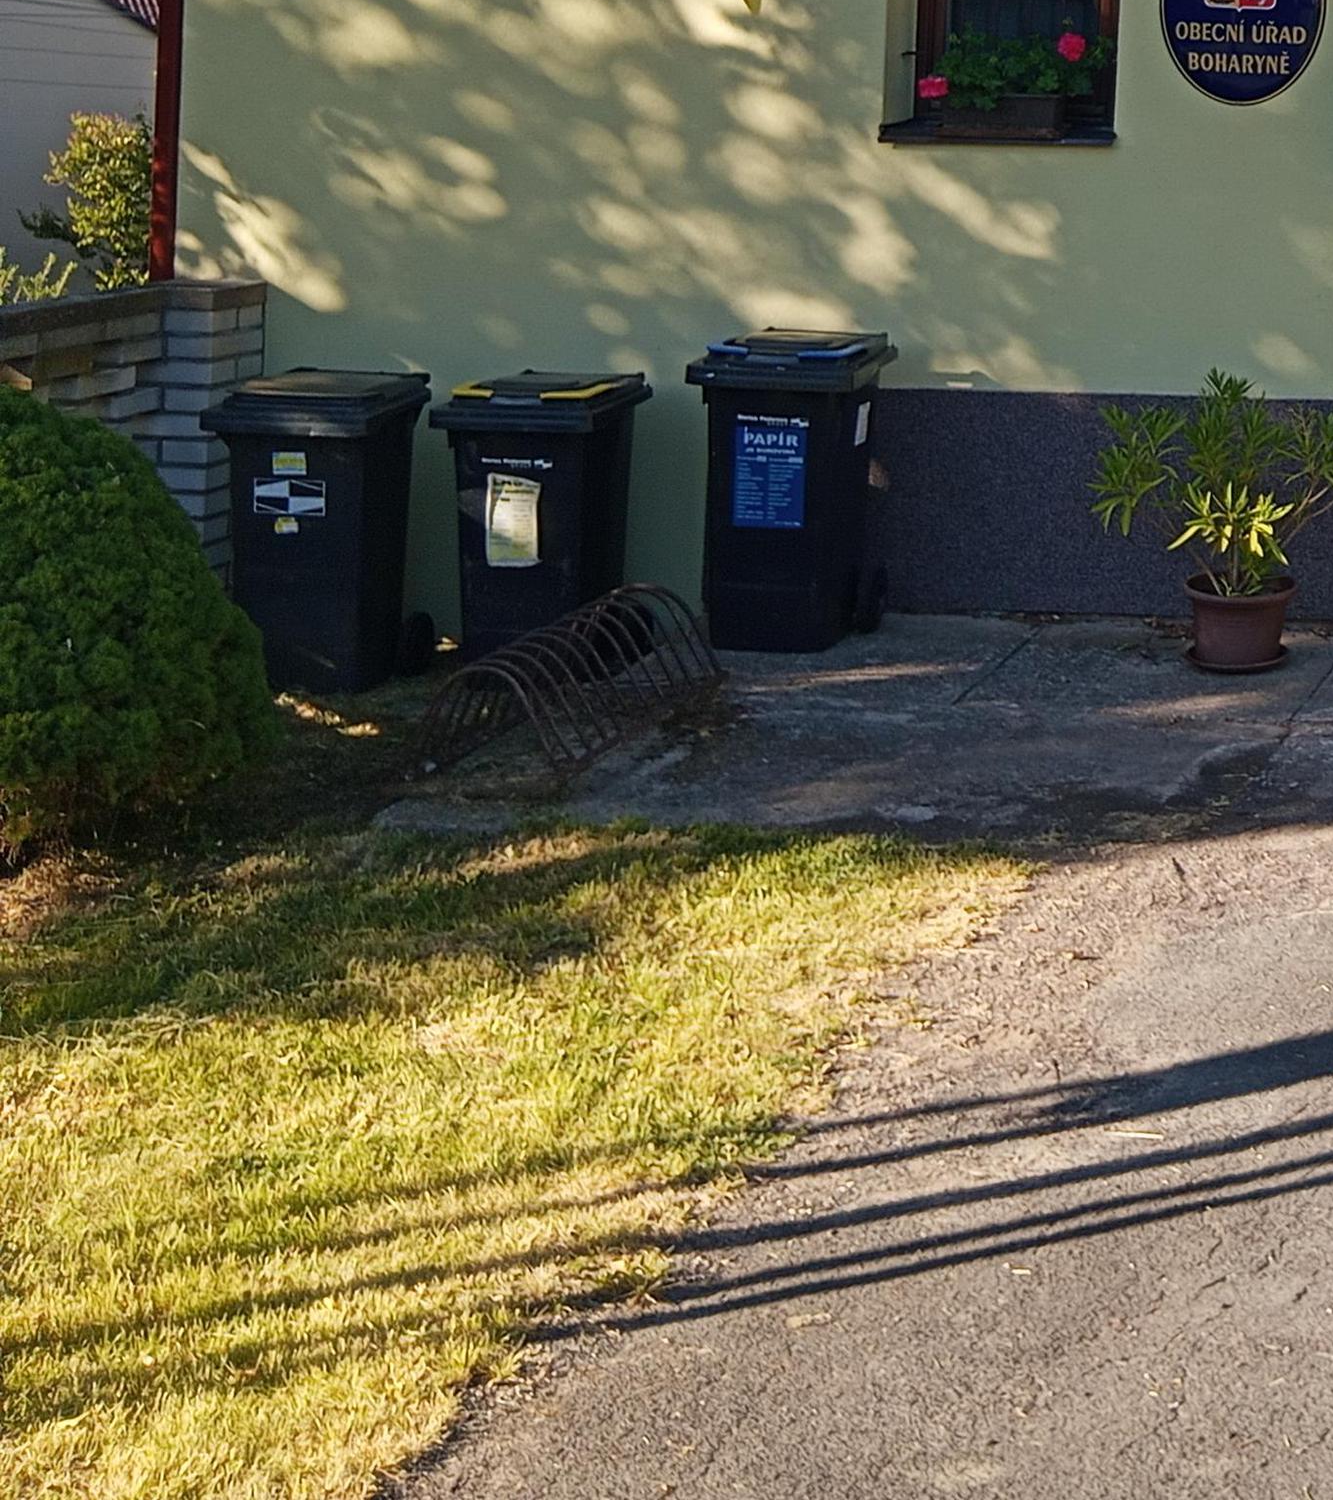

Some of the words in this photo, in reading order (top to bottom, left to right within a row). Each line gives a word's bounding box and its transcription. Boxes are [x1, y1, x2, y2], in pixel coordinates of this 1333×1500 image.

[1175, 20, 1244, 43] OBECNÍ
[1252, 20, 1307, 45] ÚŘAD
[1188, 52, 1290, 75] BOHARYNĚ
[743, 426, 799, 447] PAPÍR
